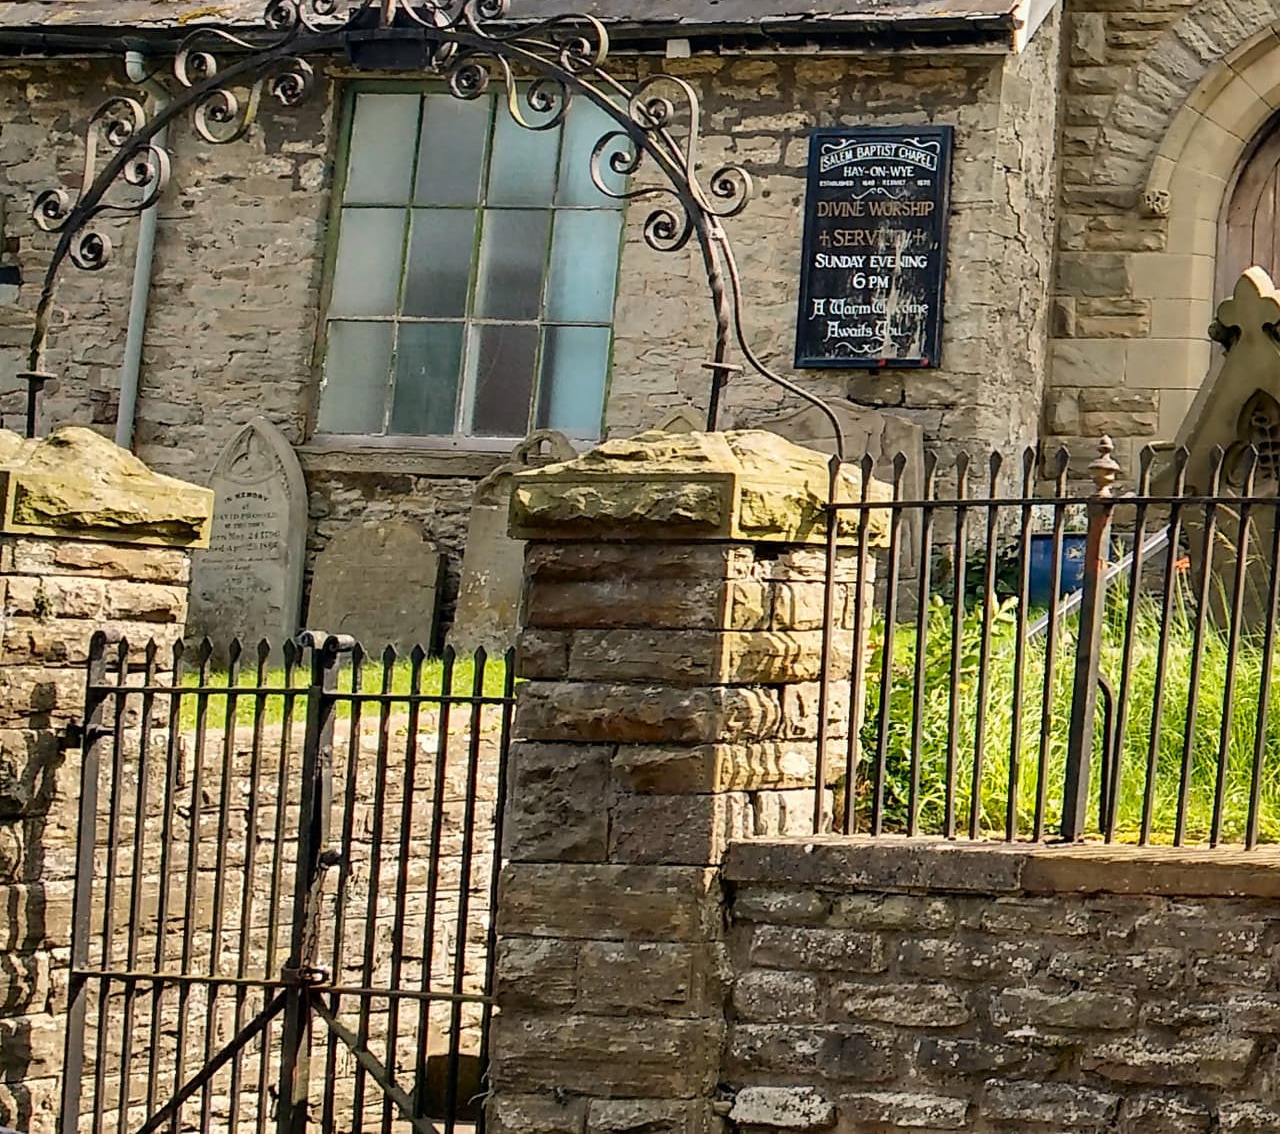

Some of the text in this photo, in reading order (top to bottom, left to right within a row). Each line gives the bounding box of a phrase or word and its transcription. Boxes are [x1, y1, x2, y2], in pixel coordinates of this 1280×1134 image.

[823, 145, 932, 167] SALEM BAPTIST CHAPEL
[843, 166, 915, 177] HAY-ON-WYE
[817, 201, 934, 217] DIVINE WORSHIP
[815, 253, 928, 268] SUNDAY EVENING
[852, 272, 890, 289] 6 PM
[829, 298, 871, 319] Warm
[822, 320, 872, 342] Awaits
